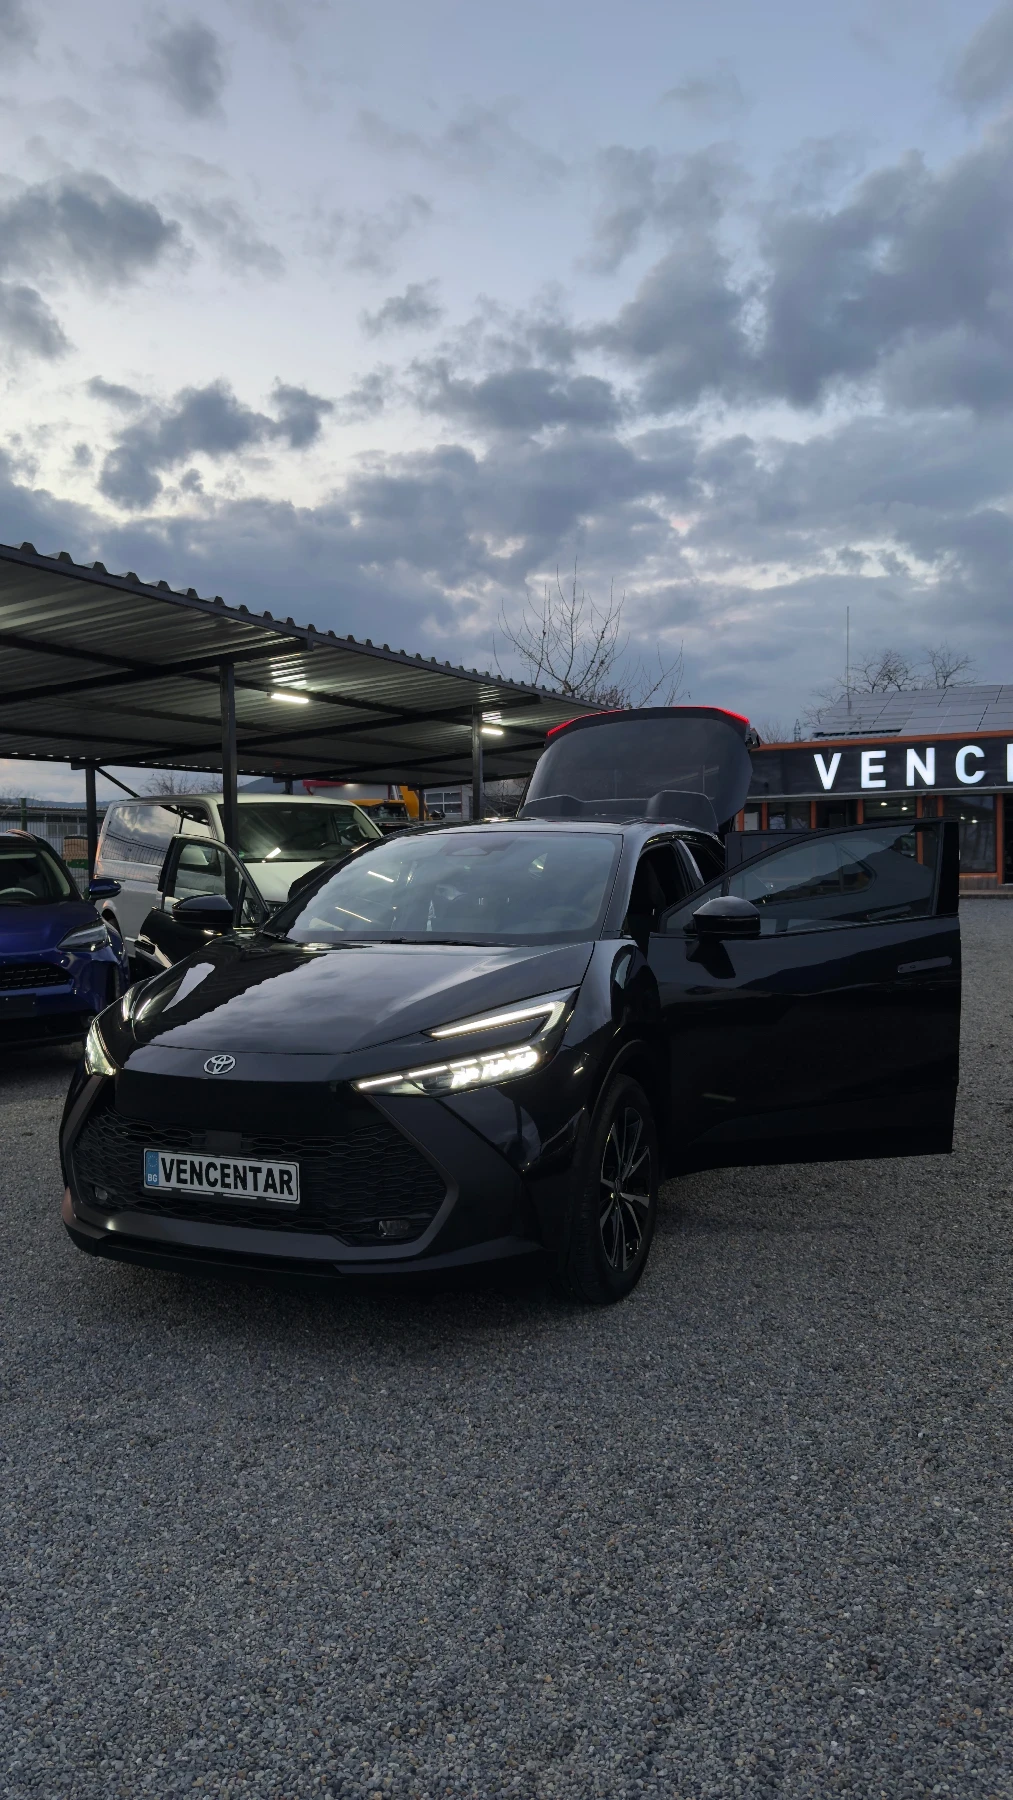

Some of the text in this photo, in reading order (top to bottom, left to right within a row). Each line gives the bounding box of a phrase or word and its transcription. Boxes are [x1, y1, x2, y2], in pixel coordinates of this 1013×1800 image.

[813, 743, 1013, 790] VENC
[147, 1173, 158, 1183] BG
[161, 1157, 294, 1196] VENCENTAR
